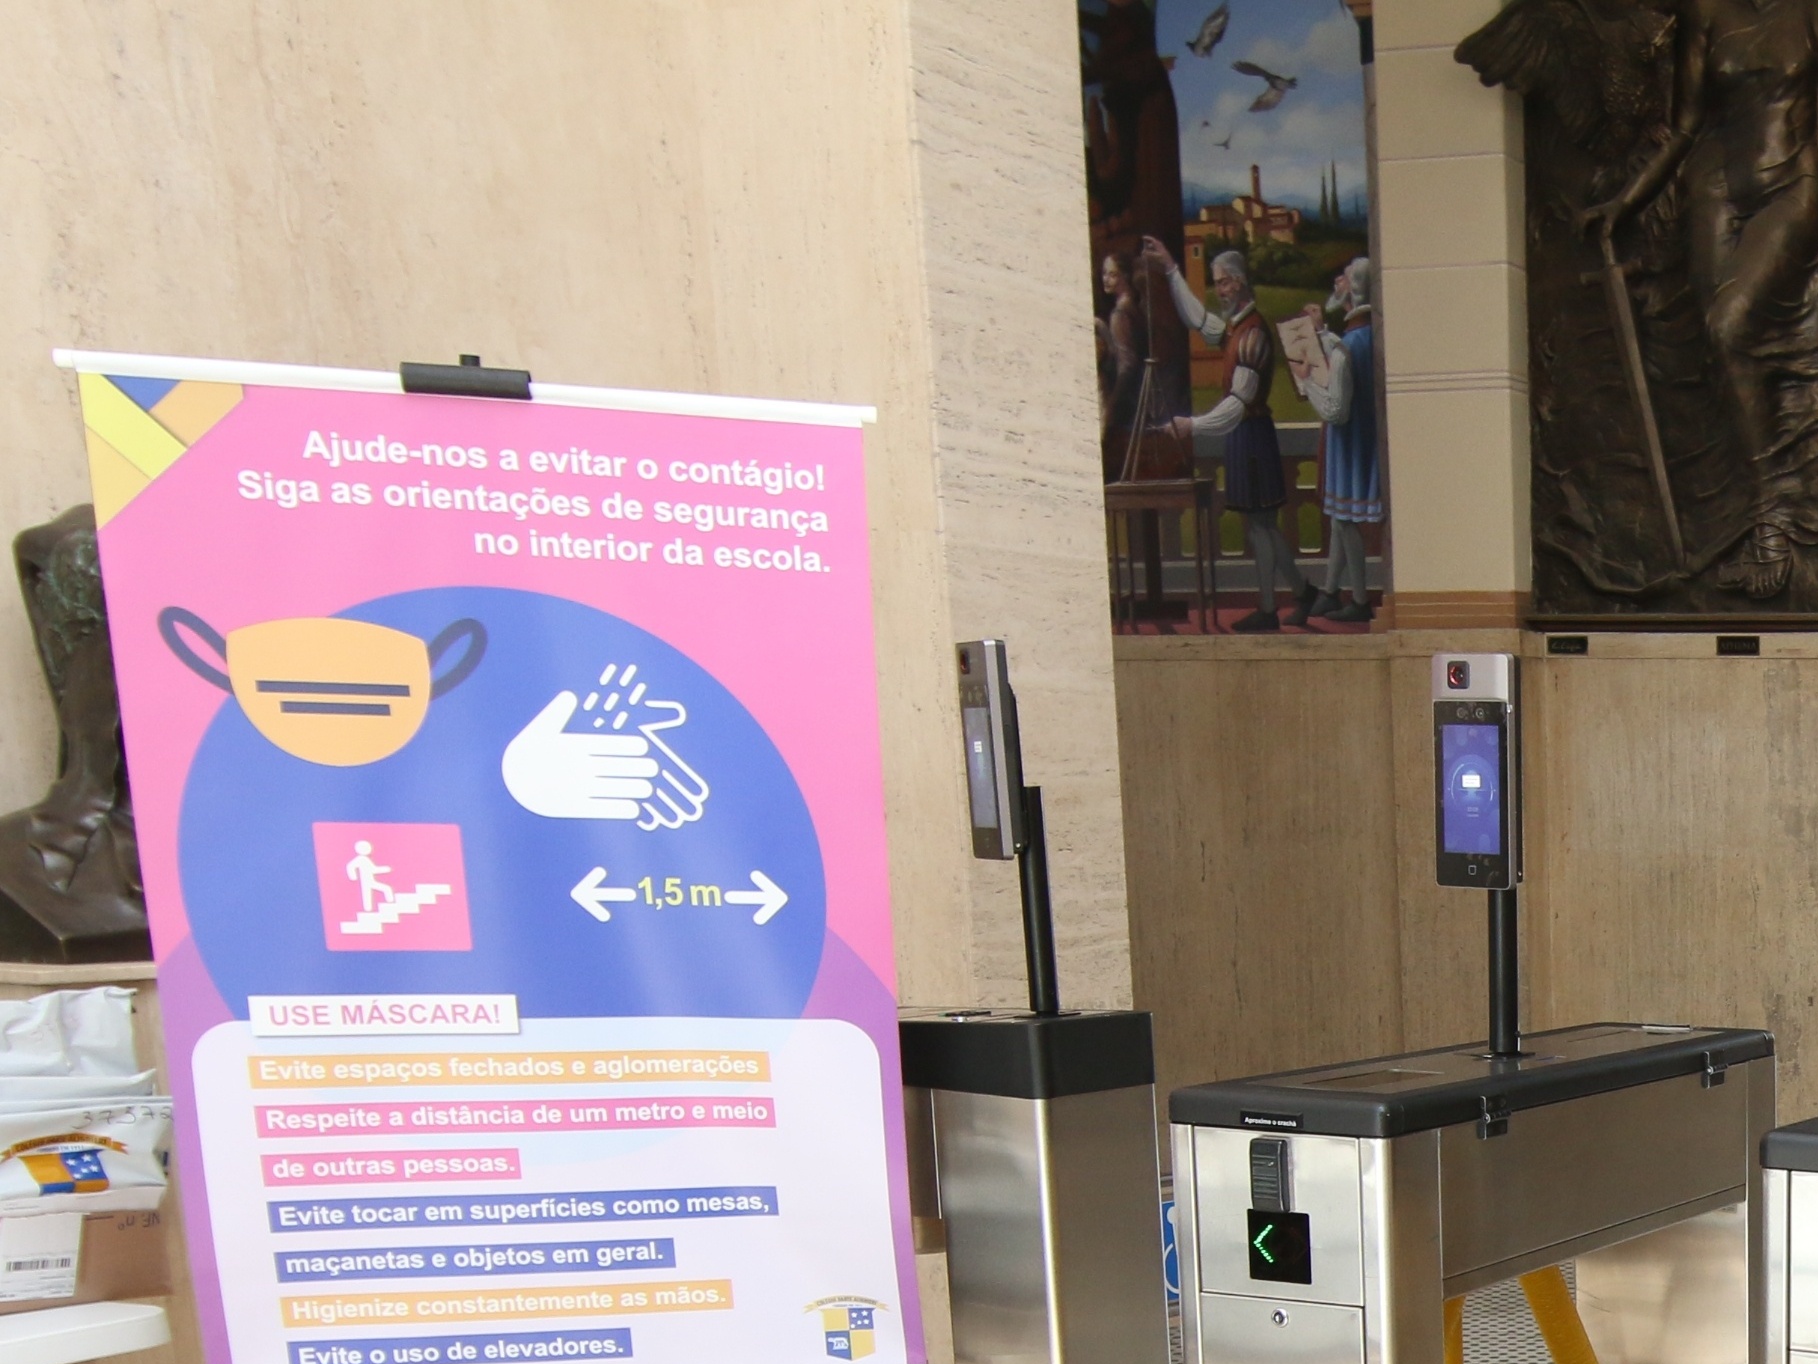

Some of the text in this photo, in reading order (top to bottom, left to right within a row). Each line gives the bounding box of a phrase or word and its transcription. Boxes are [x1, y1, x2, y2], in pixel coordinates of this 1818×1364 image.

[302, 429, 825, 497] Ajude-nos a evitar o contágio!
[237, 468, 829, 539] Siga as orientações de segurança
[474, 527, 831, 574] no interior da escola.
[636, 876, 723, 910] 1,5 m
[269, 996, 501, 1027] USE MÁSCARA!
[258, 1053, 759, 1084] Evite espaços fechados e aglomerações
[265, 1100, 768, 1134] Respeite a distância de um metro e meio
[272, 1156, 516, 1180] de outras pessoas.
[278, 1194, 769, 1227] Evite tocar em superfícies como mesas,
[285, 1240, 664, 1278] maçanetas e objetos em geral.
[291, 1285, 726, 1325] Higienize constantemente as mãos.
[392, 1346, 440, 1364] uso
[446, 1340, 477, 1362] de
[483, 1336, 624, 1360] elevadores.
